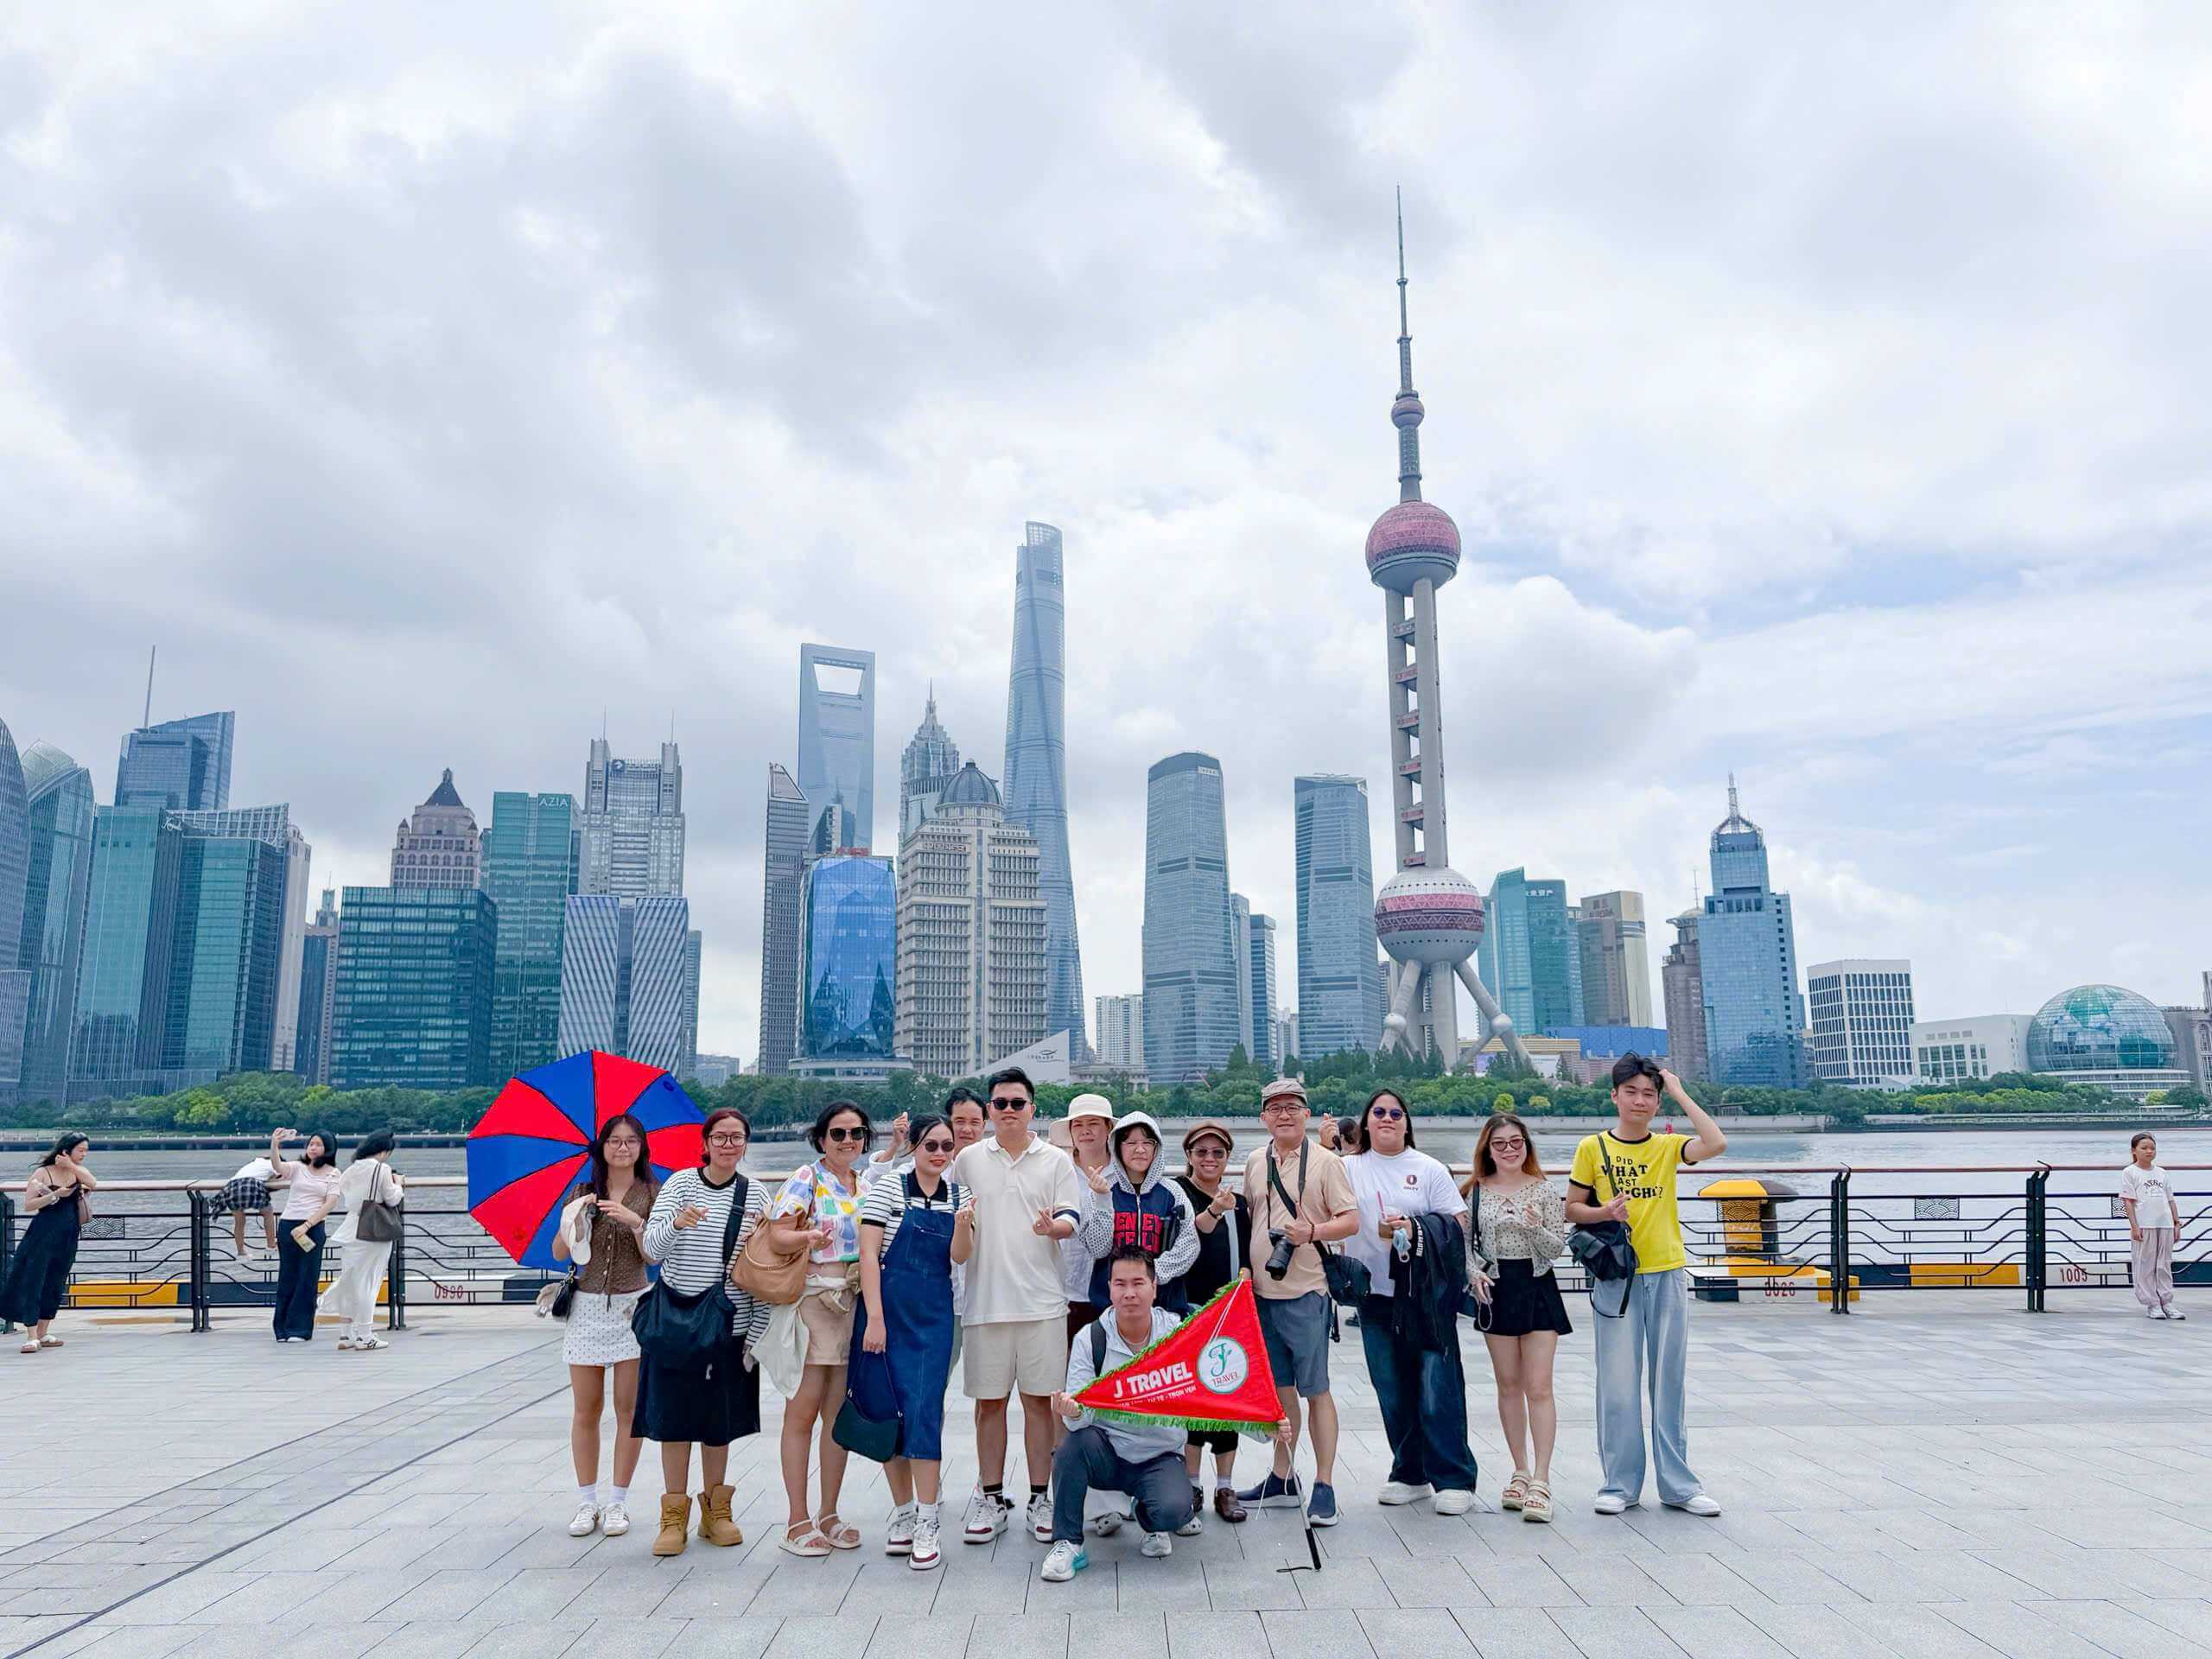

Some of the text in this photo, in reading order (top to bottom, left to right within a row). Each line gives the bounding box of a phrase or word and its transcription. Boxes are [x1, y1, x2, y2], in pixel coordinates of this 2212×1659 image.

[538, 797, 568, 807] AZIA
[1616, 1155, 1633, 1165] DID
[1127, 1361, 1193, 1395] TRAVEL
